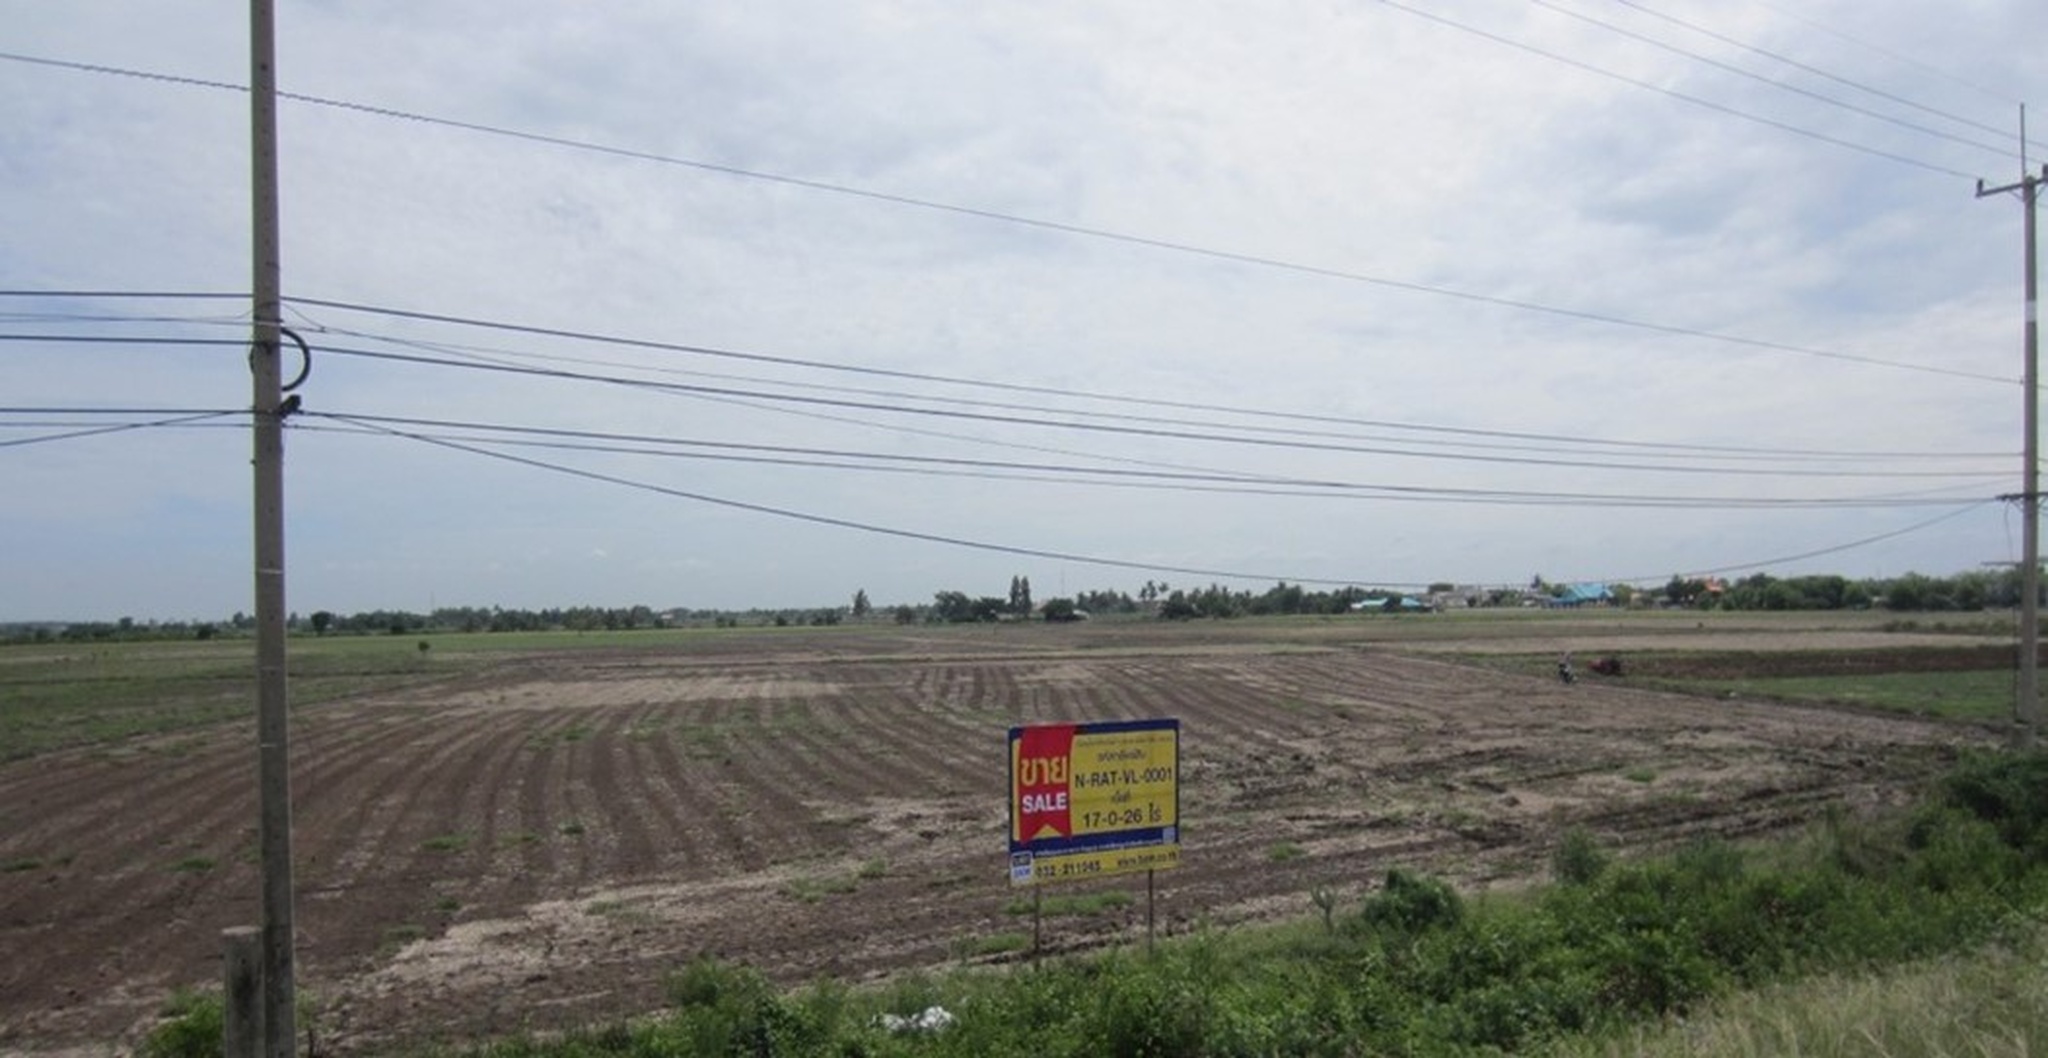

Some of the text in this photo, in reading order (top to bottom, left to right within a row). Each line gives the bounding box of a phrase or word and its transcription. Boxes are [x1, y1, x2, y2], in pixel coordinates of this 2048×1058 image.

[1021, 756, 1067, 786] ขาย
[1075, 767, 1172, 788] N-RAT-VL-0001
[1022, 792, 1067, 814] SALE
[1083, 808, 1143, 827] 17-0-26
